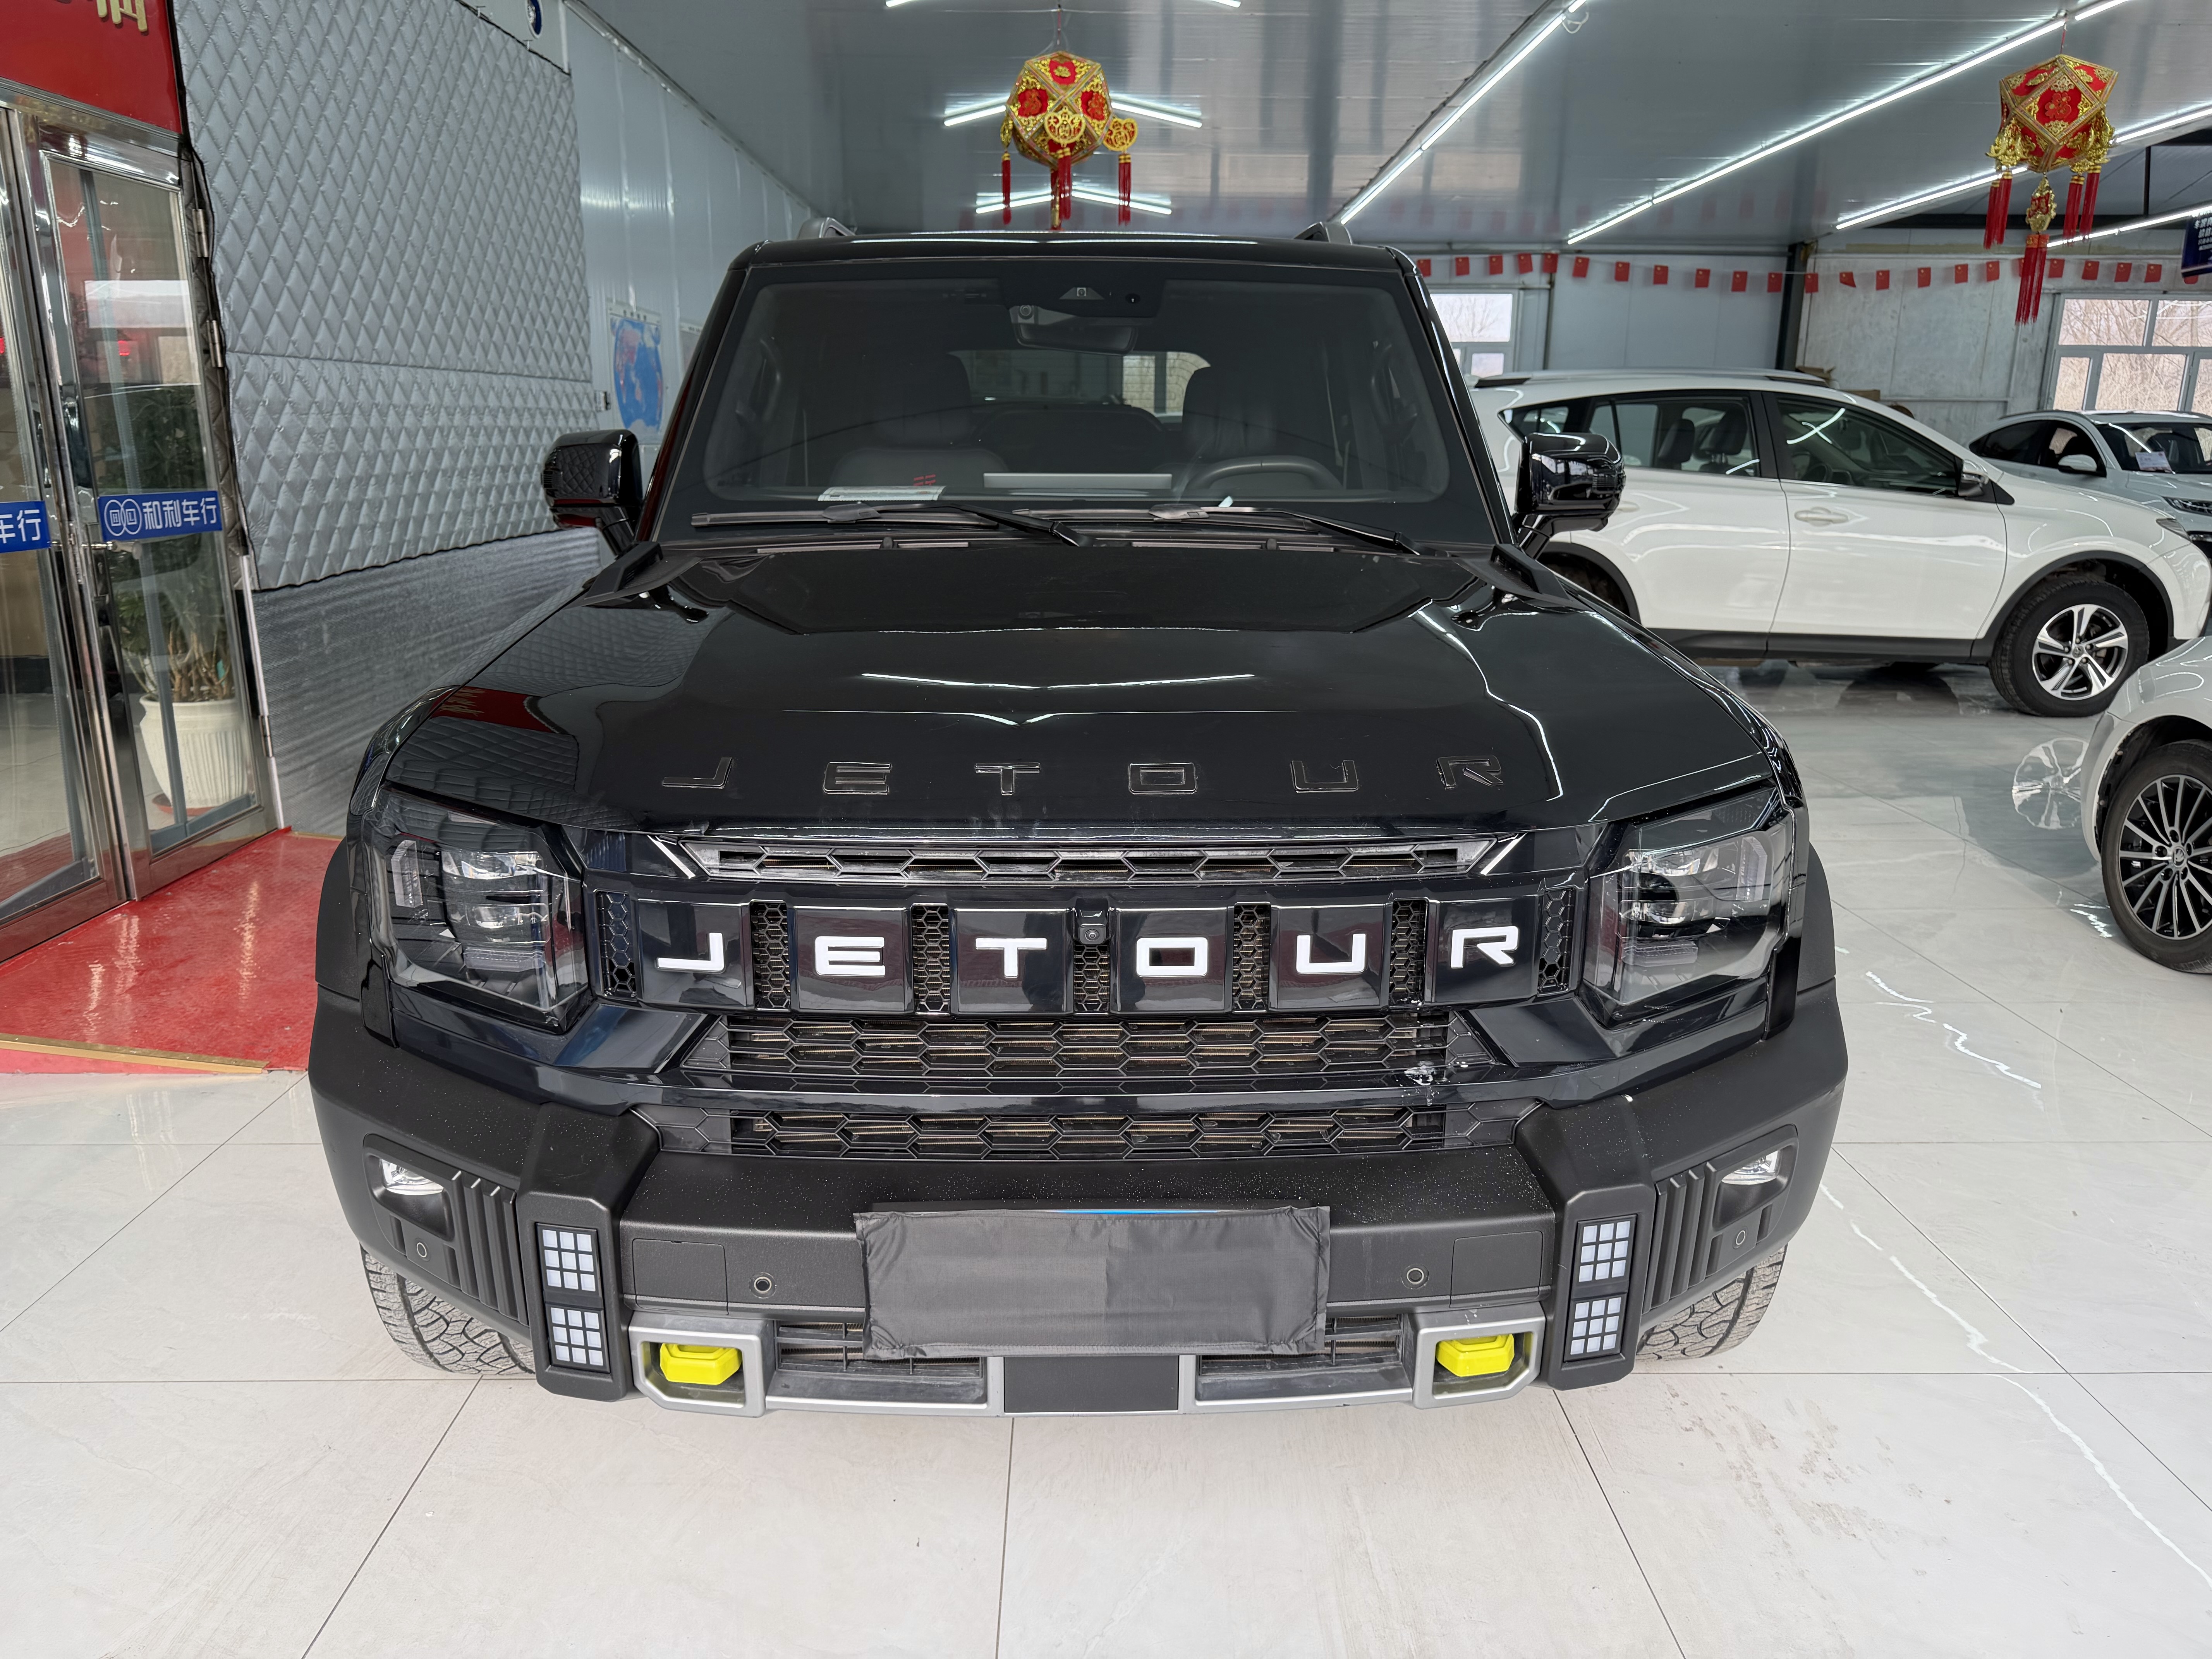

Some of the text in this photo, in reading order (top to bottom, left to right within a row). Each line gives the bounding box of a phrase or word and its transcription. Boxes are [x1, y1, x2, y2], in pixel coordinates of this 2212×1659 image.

[142, 497, 217, 530] 和利车行
[661, 754, 1504, 796] JETOUR
[656, 926, 1519, 978] JETOUR
